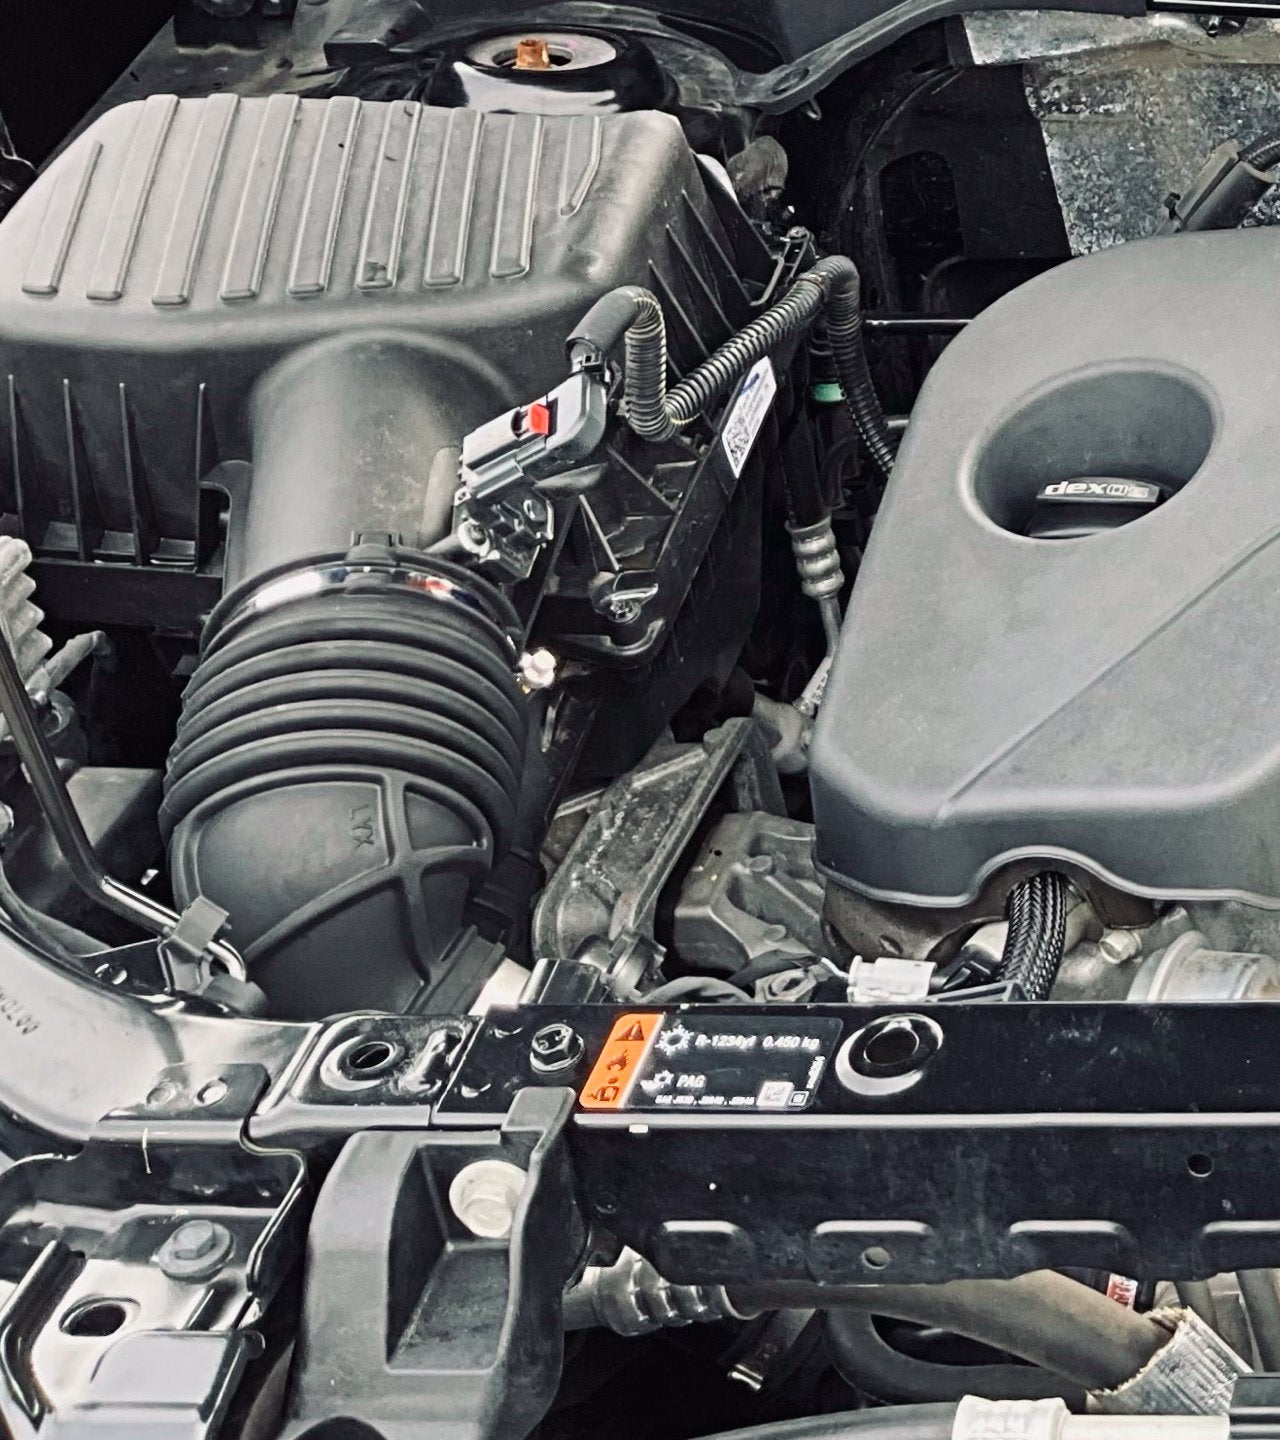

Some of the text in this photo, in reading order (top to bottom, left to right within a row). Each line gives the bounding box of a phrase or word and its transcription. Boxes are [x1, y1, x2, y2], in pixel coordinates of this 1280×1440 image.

[1044, 481, 1150, 499] dexos
[351, 804, 375, 851] LYX
[801, 1036, 821, 1051] kg
[676, 1073, 706, 1089] PAG
